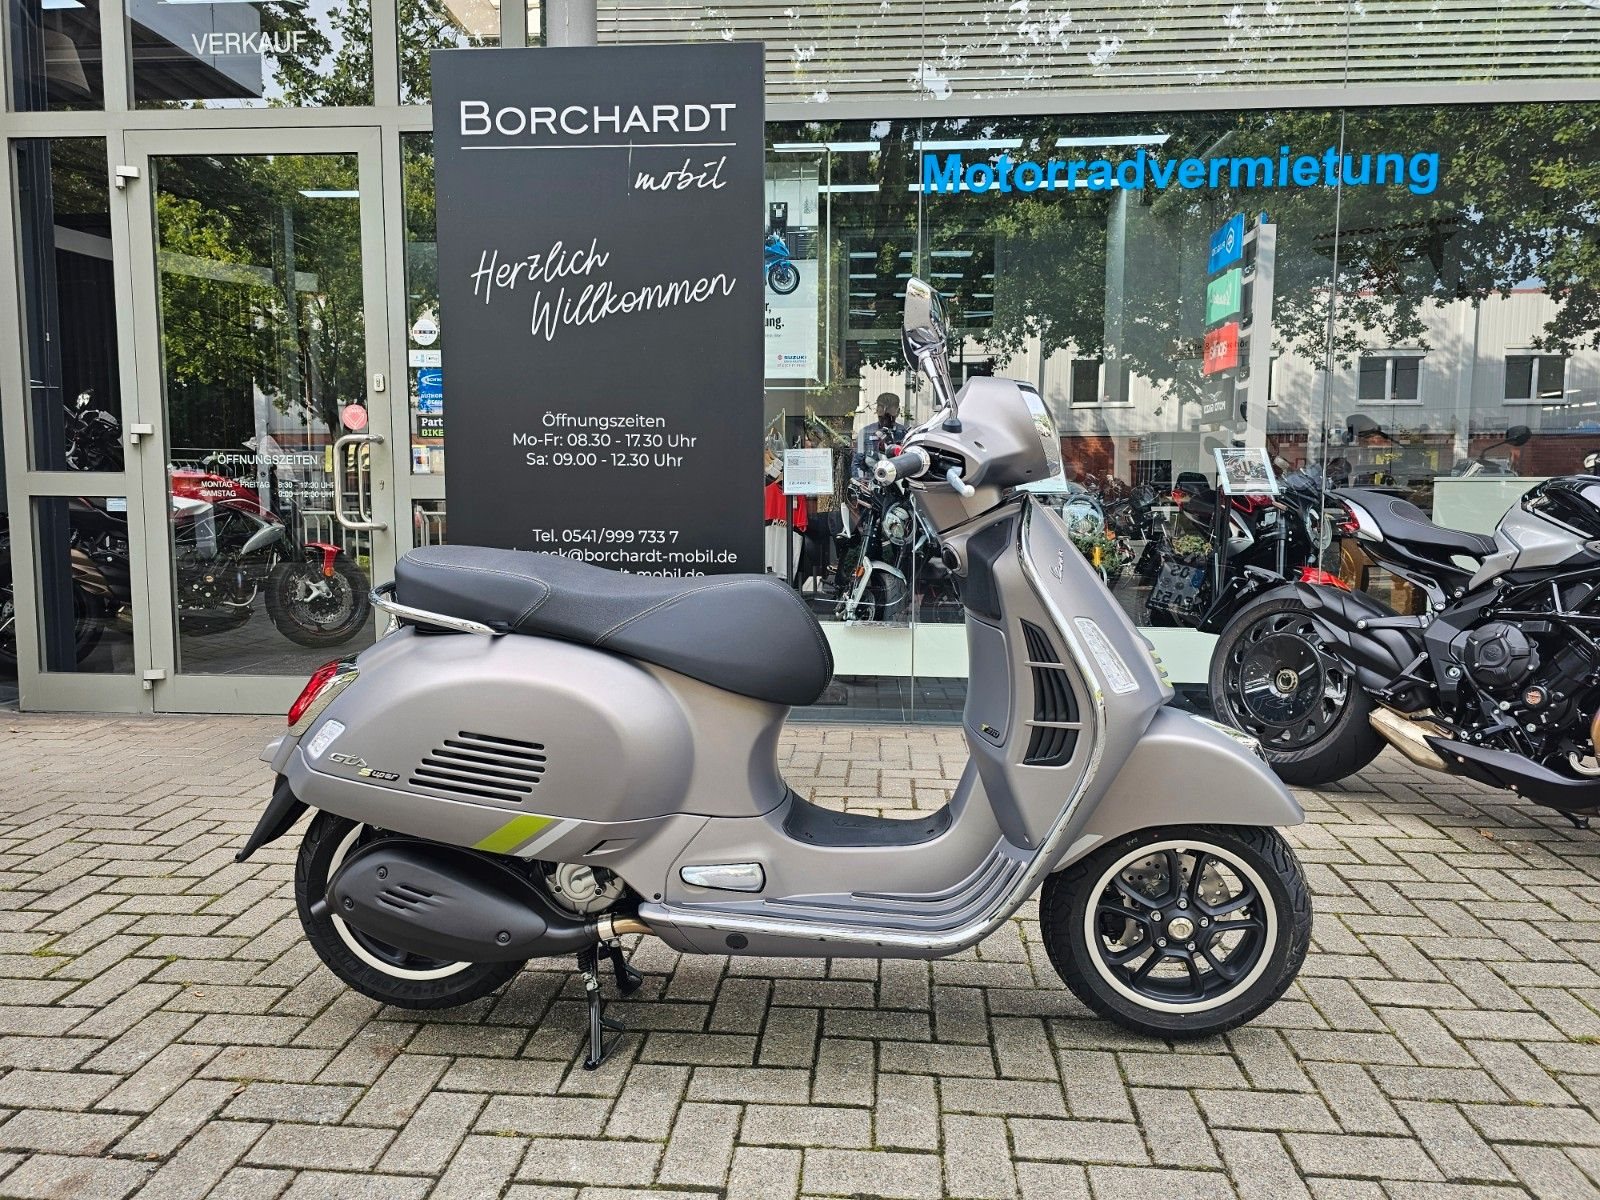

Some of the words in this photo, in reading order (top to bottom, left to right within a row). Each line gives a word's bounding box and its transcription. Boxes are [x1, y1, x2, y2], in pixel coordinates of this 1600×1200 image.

[192, 31, 307, 55] VERKAUF
[460, 100, 736, 136] BORCHARDT
[634, 156, 727, 191] mobil
[923, 146, 1440, 195] Motorradvermietung
[470, 238, 609, 304] Herzlich
[531, 273, 736, 341] Willkommen
[421, 417, 444, 427] Part
[542, 411, 666, 430] Öffnungszeiten
[421, 429, 444, 437] BIKE
[513, 433, 563, 447] Mo-Fr:
[567, 433, 611, 447] 08.30
[625, 434, 663, 448] 17.30
[668, 434, 697, 448] Uhr
[217, 453, 318, 465] ÖFFNUNGSZEITEN
[526, 453, 549, 466] Sa:
[553, 453, 597, 467] 09.00
[611, 453, 650, 467] 12.30
[654, 454, 683, 467] Uhr
[532, 529, 558, 543] Tel.
[562, 528, 635, 544] 0541/999
[639, 530, 665, 544] 733
[669, 530, 679, 543] 7
[357, 767, 399, 781] Super
